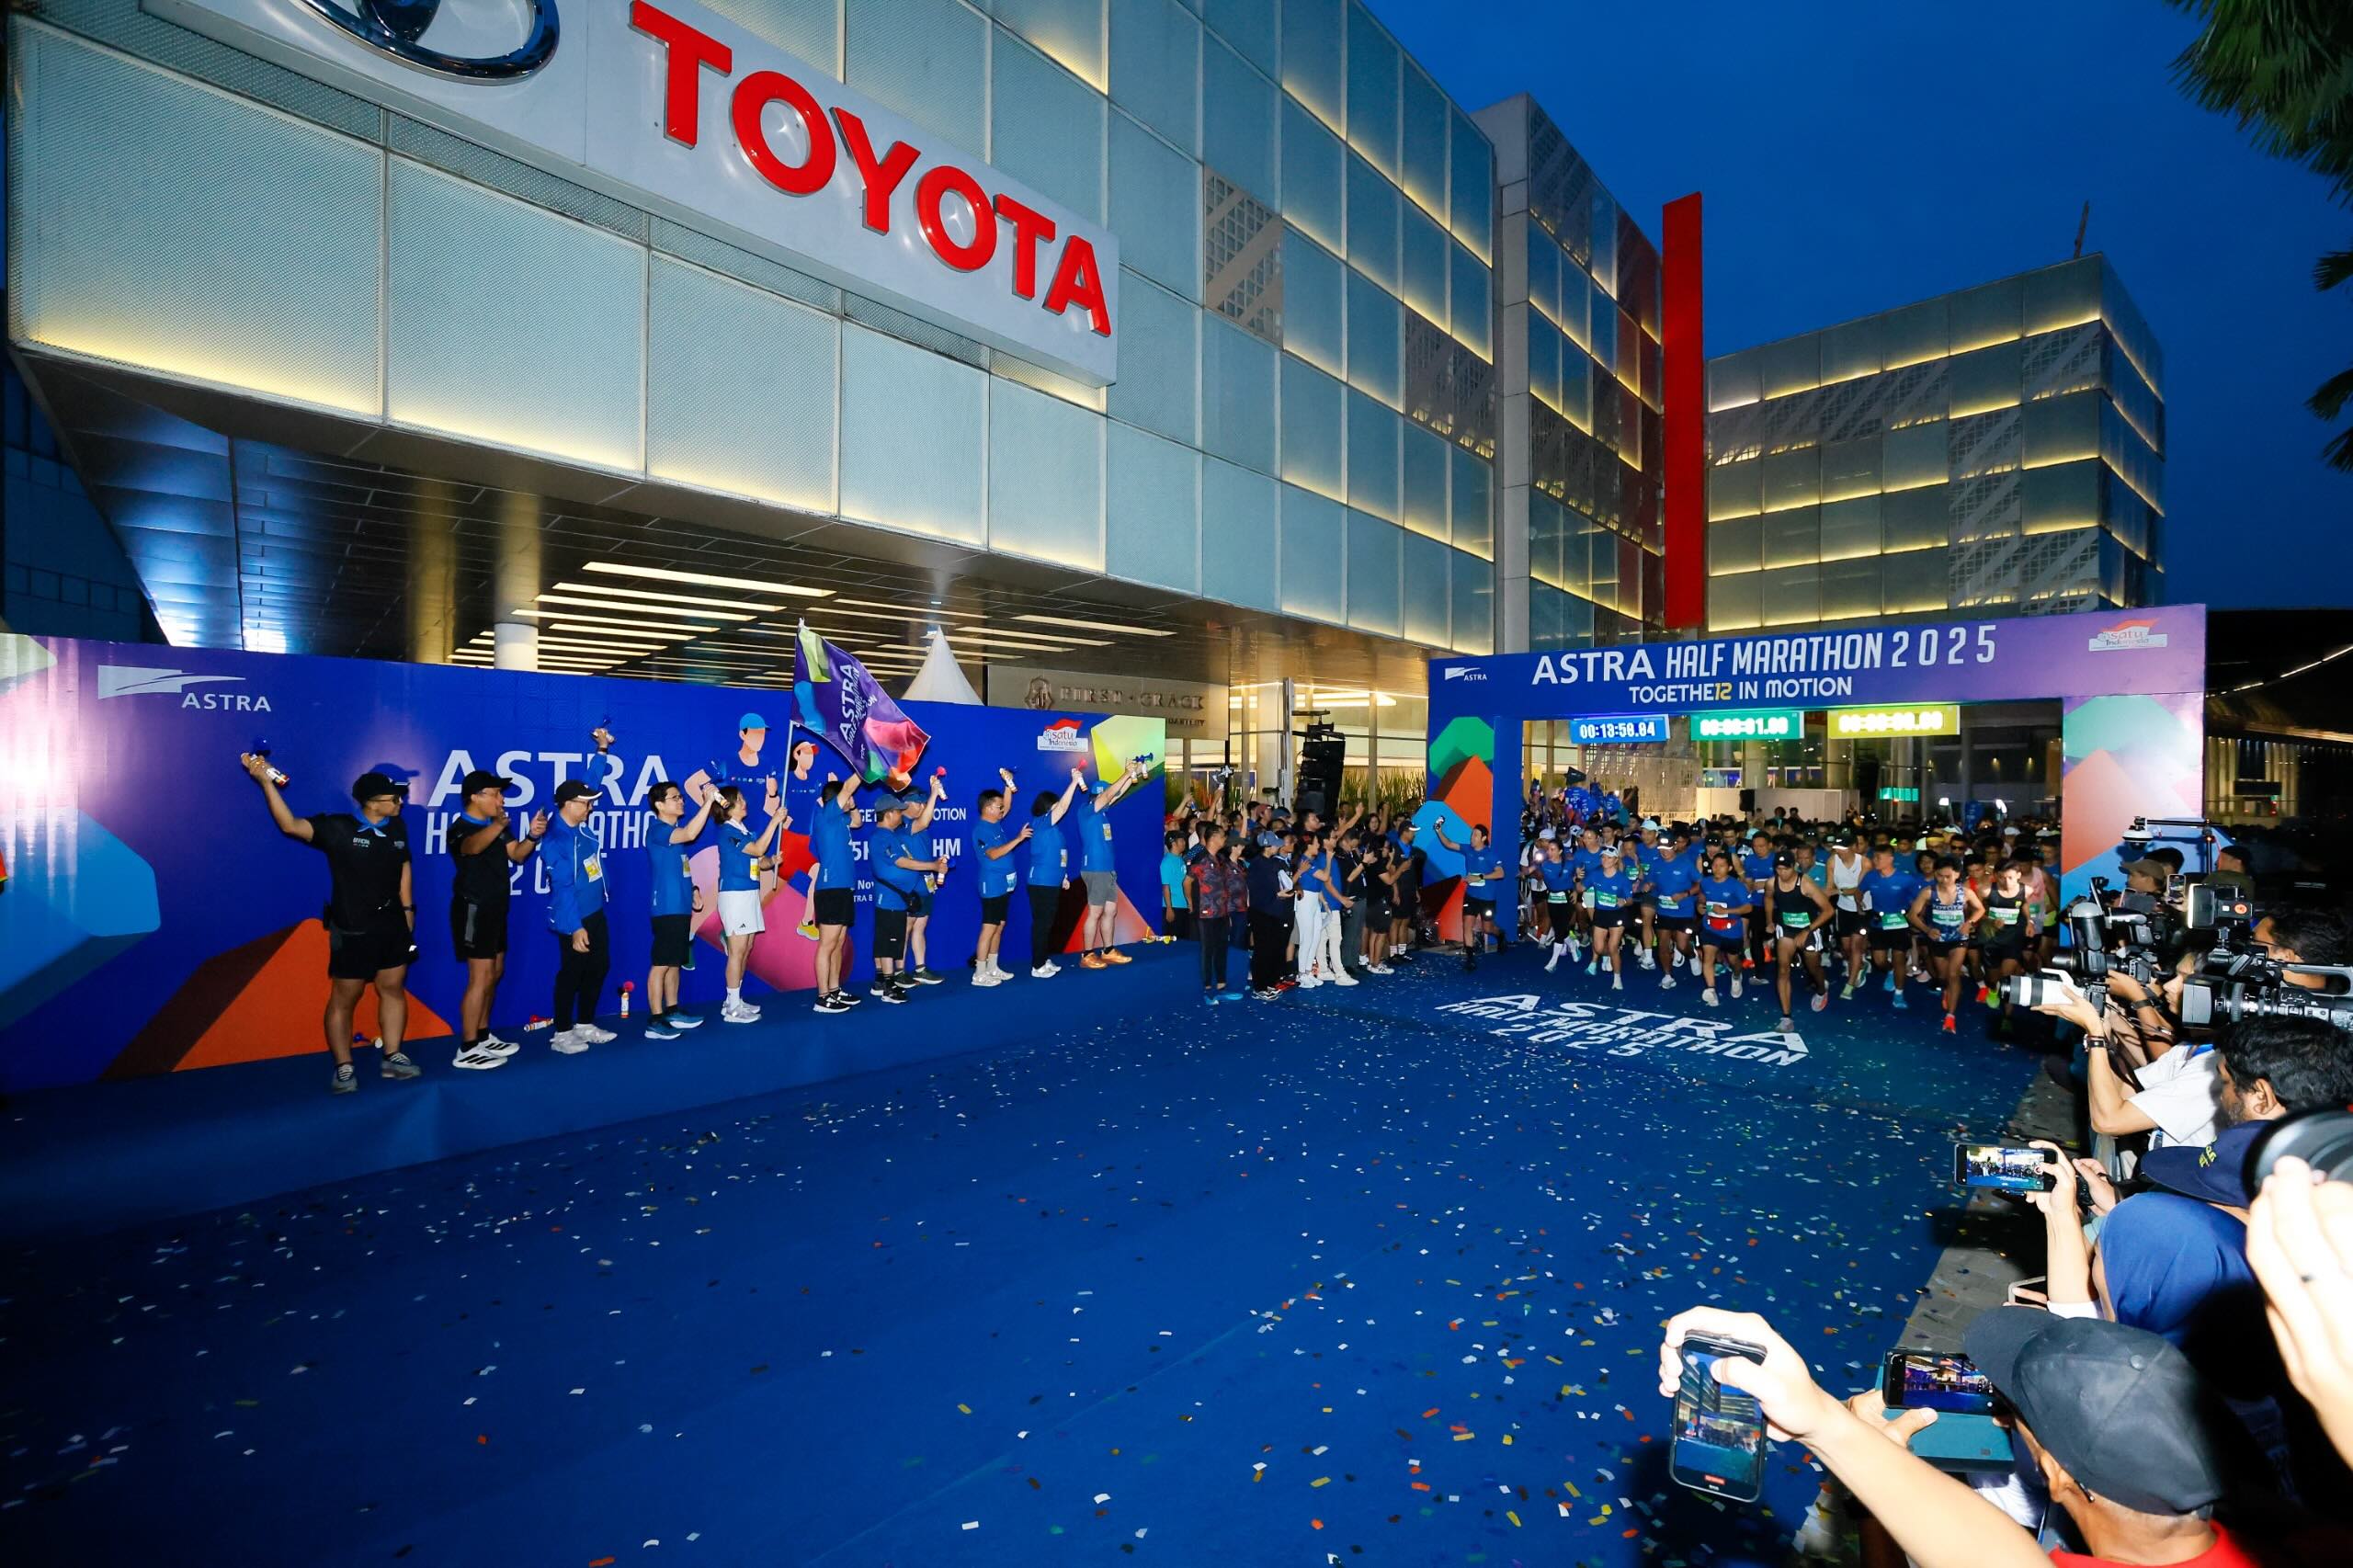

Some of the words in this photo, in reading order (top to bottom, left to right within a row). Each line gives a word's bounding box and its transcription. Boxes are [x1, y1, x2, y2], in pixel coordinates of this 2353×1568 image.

[629, 0, 1110, 337] TOYOTA
[1532, 649, 1655, 685] ASTRA
[1665, 643, 1725, 678] HALF
[1733, 632, 1883, 675] MARATHON
[1891, 625, 1996, 668] 2025
[182, 692, 271, 711] ASTRA
[839, 664, 856, 742] ASTRA
[1739, 681, 1757, 699] IN
[1765, 676, 1852, 699] MOTION
[1051, 731, 1074, 740] satu
[932, 807, 967, 822] OTION
[932, 837, 961, 858] HM
[1434, 1001, 1544, 1022] HALF
[1540, 1017, 1809, 1066] MARATHON
[1469, 994, 1810, 1054] ASTRA
[1491, 1024, 1656, 1058] 2025
